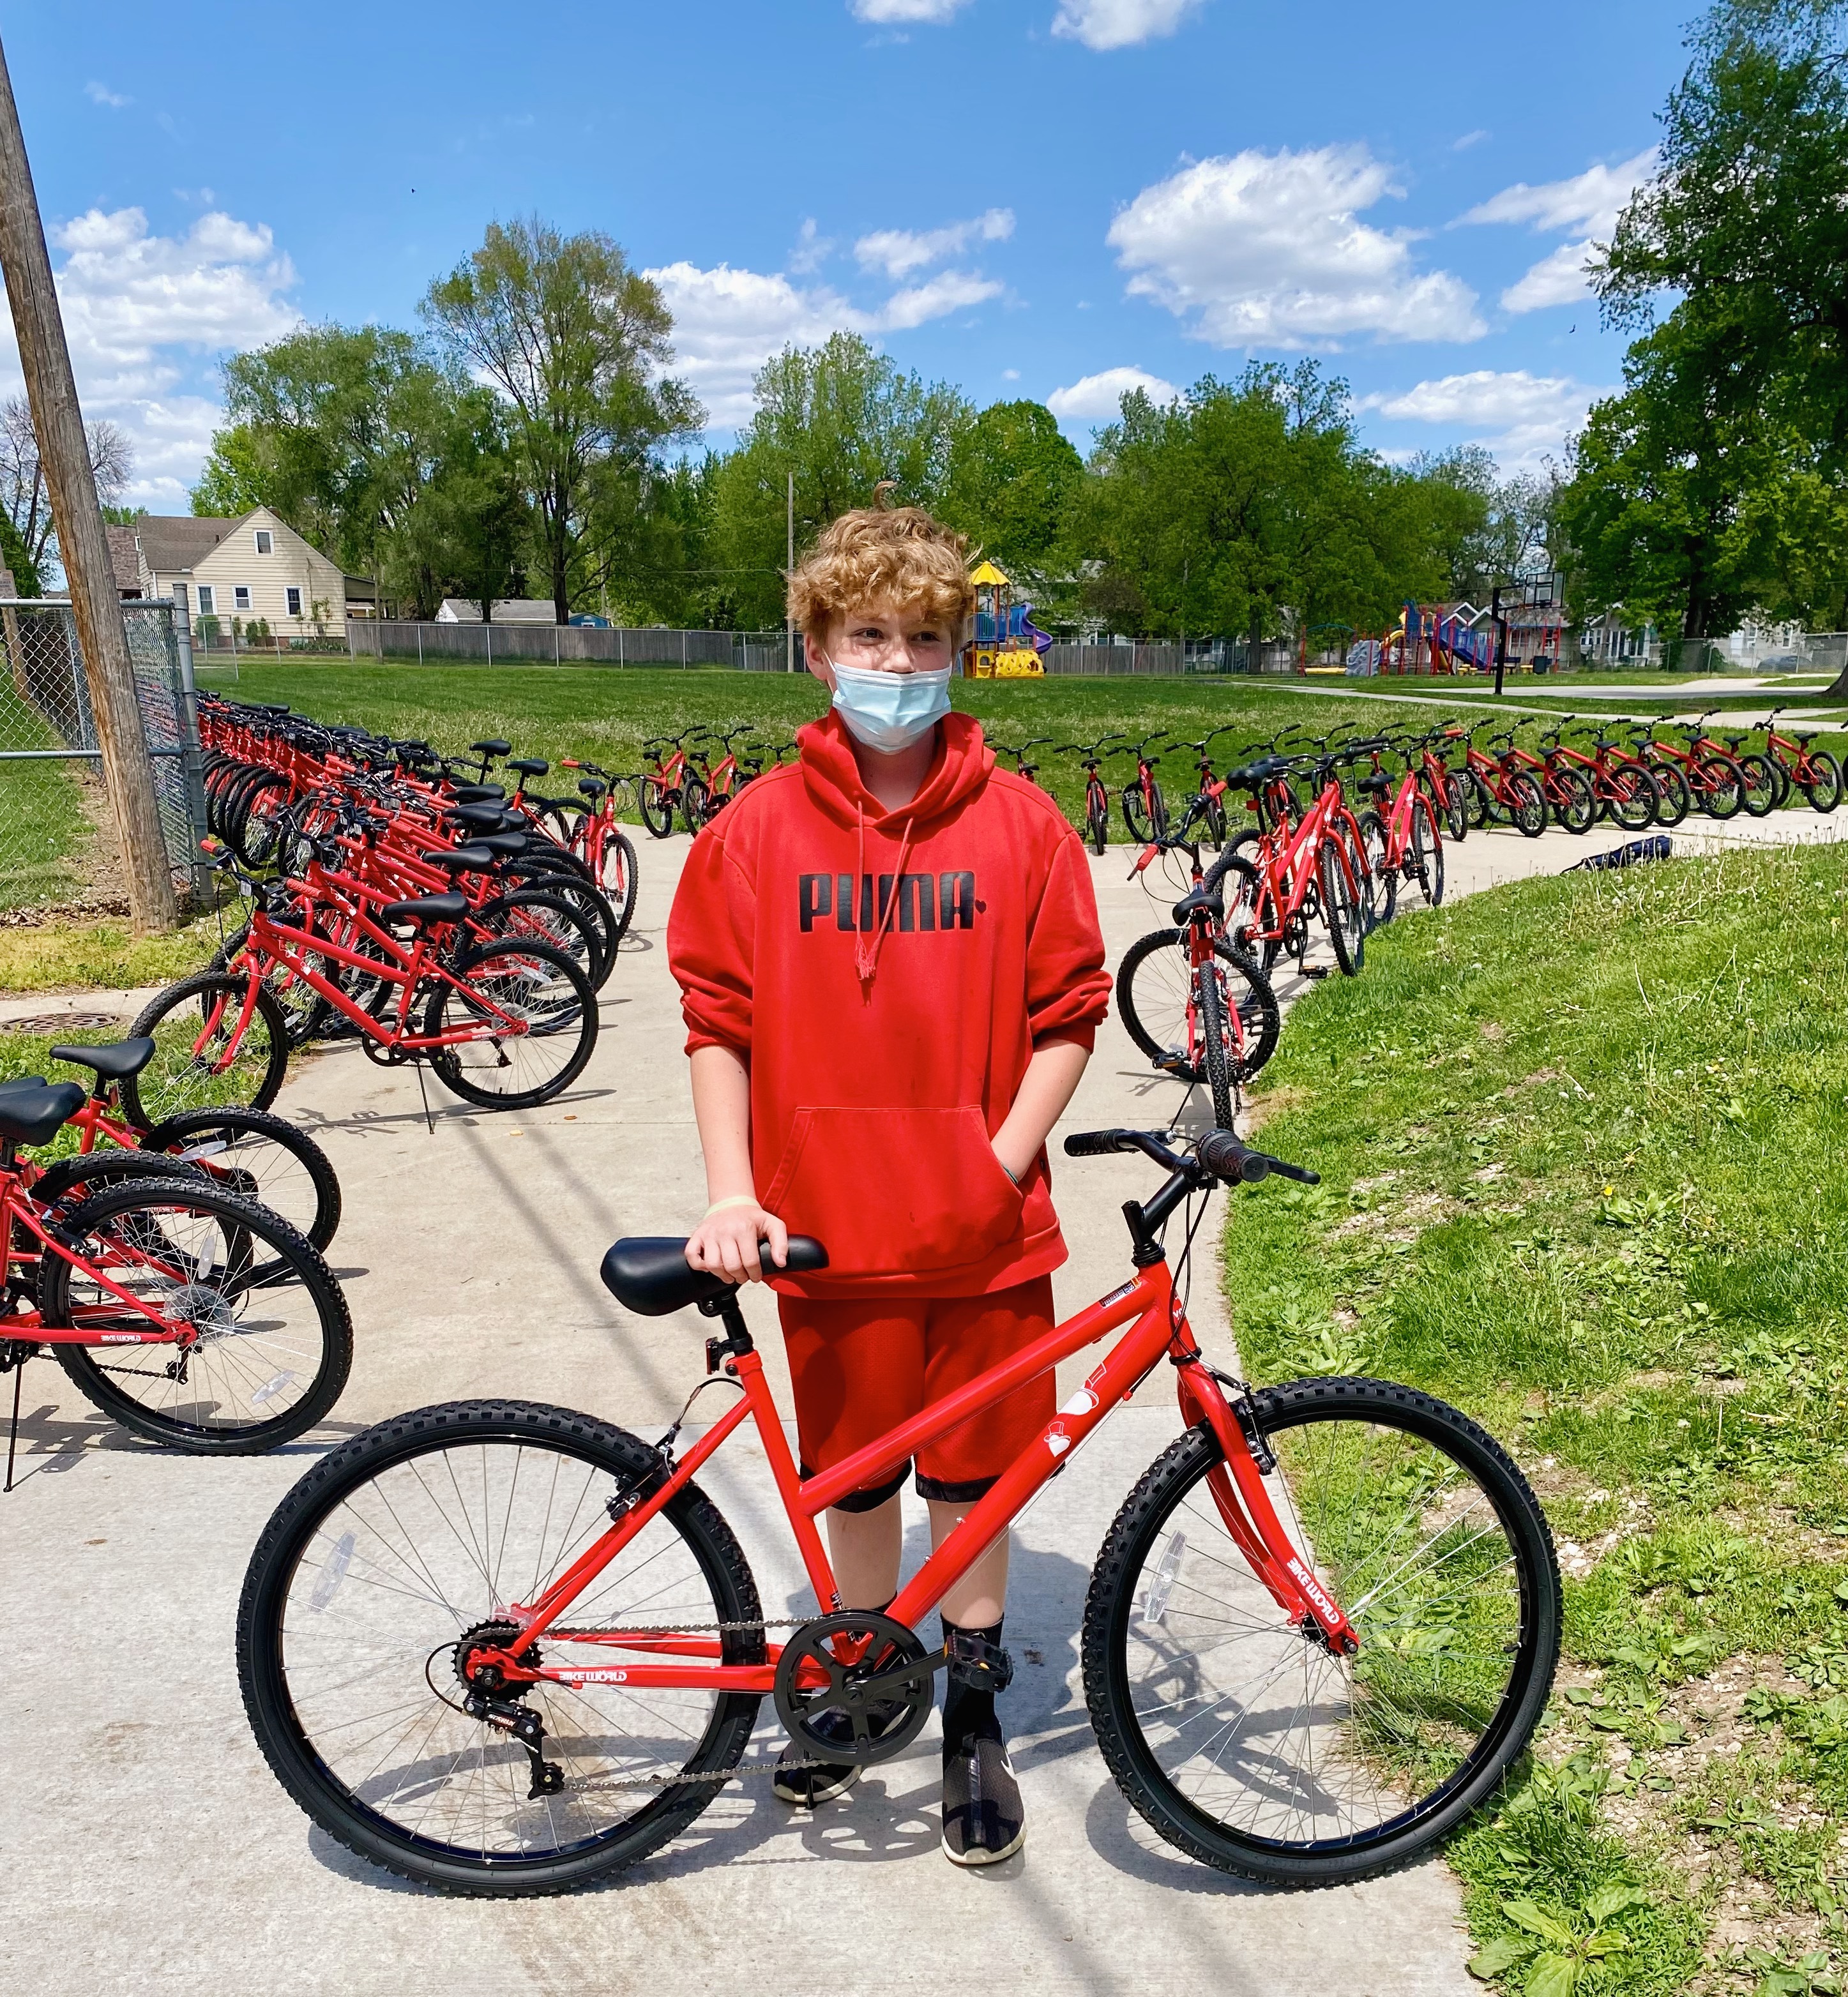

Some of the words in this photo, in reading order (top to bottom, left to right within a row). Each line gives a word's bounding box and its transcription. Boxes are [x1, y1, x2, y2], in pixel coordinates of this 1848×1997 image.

[799, 871, 974, 931] PUMA
[1287, 1557, 1312, 1586] BIKE
[1305, 1581, 1340, 1624] WORLD
[559, 1672, 584, 1681] BIKE
[586, 1670, 627, 1682] WORLD
